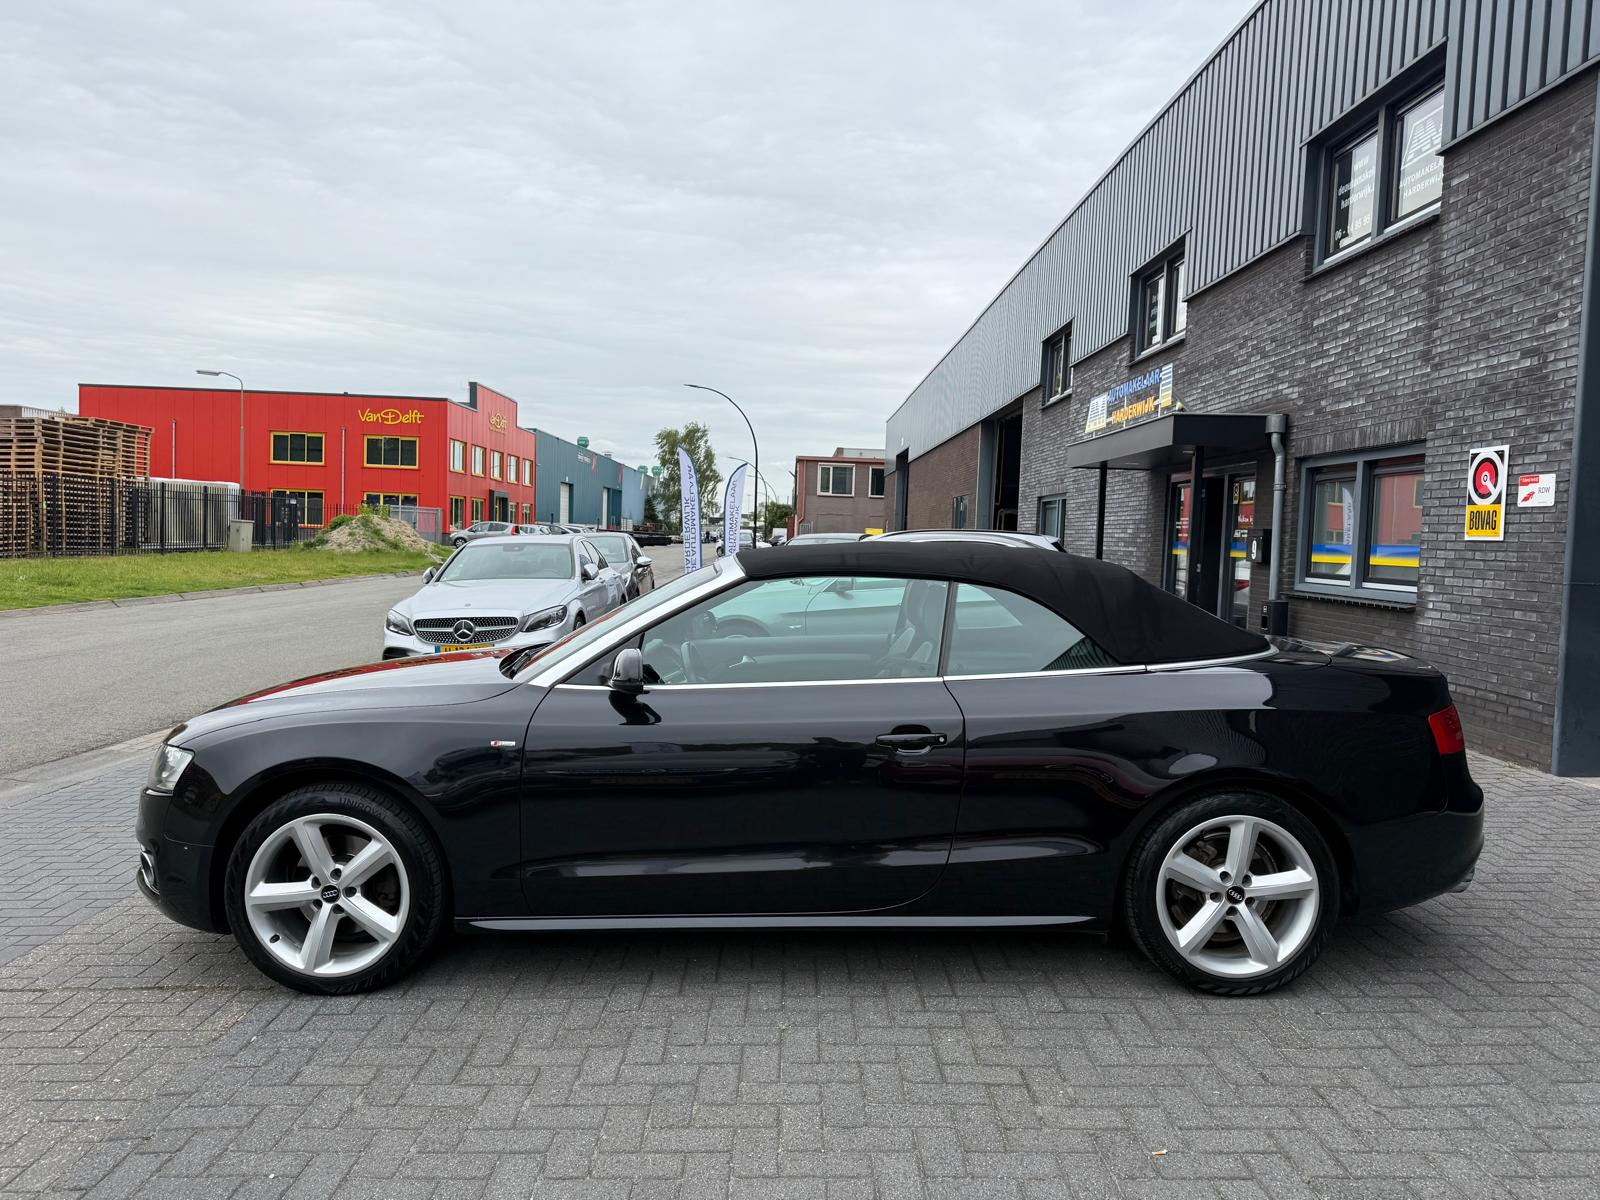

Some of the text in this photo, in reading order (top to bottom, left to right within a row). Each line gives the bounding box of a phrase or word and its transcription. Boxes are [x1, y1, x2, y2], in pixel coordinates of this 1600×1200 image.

[1107, 368, 1160, 403] AUTOMAKELAAR
[1111, 395, 1155, 425] HARDERWIJK
[1469, 510, 1497, 531] BOVAG
[1251, 540, 1257, 560] 9
